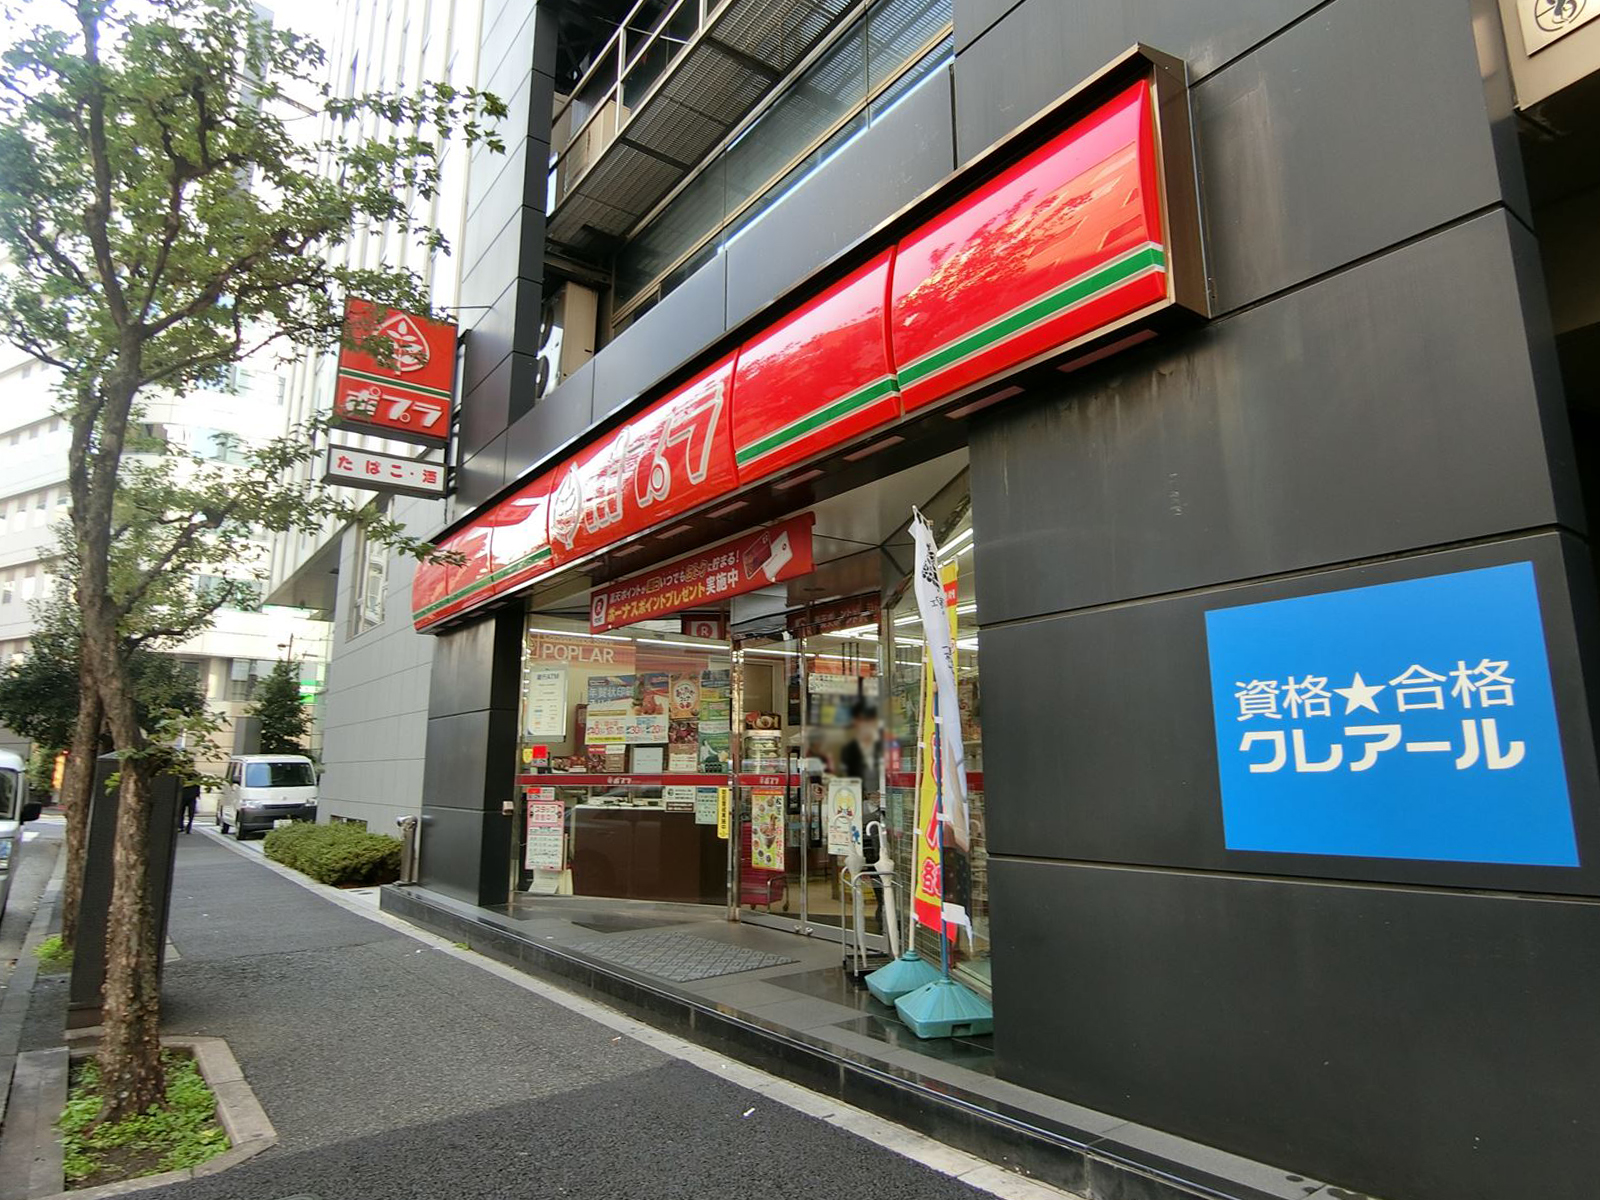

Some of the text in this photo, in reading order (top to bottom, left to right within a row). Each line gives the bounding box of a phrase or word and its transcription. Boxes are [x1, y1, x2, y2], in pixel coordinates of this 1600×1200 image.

[345, 386, 443, 428] ポプラ
[607, 568, 739, 622] ボーナスポイントプレゼント実施中
[542, 643, 615, 664] POPLAR
[1239, 718, 1525, 773] クレアール
